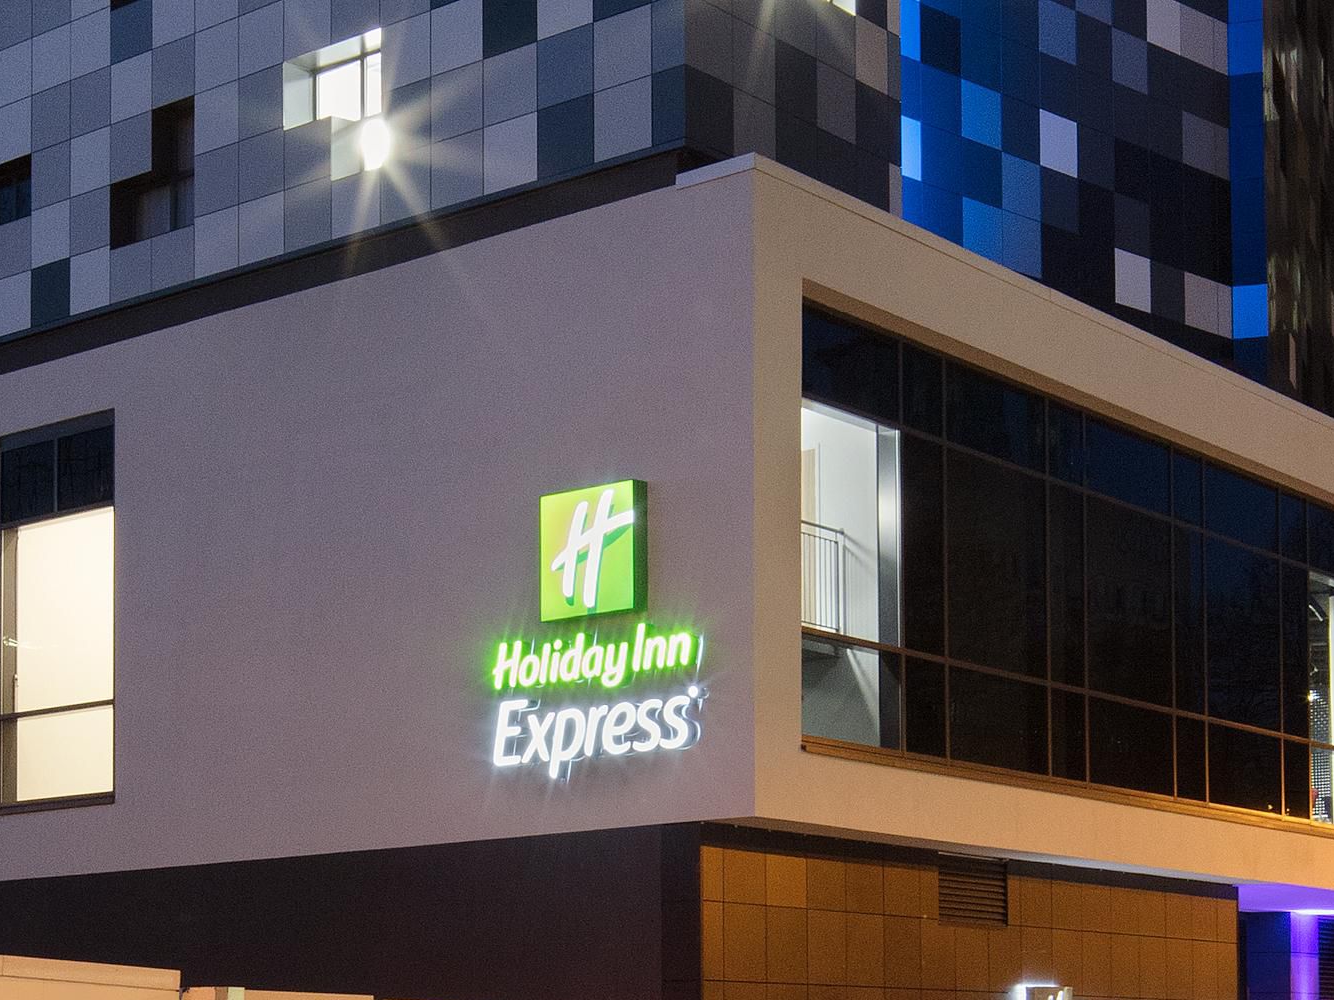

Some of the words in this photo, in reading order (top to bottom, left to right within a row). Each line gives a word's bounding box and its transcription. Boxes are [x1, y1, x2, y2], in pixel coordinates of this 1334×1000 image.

[551, 488, 634, 608] H
[493, 631, 628, 689] Holiday
[632, 622, 693, 672] Inn
[492, 693, 693, 779] Express
